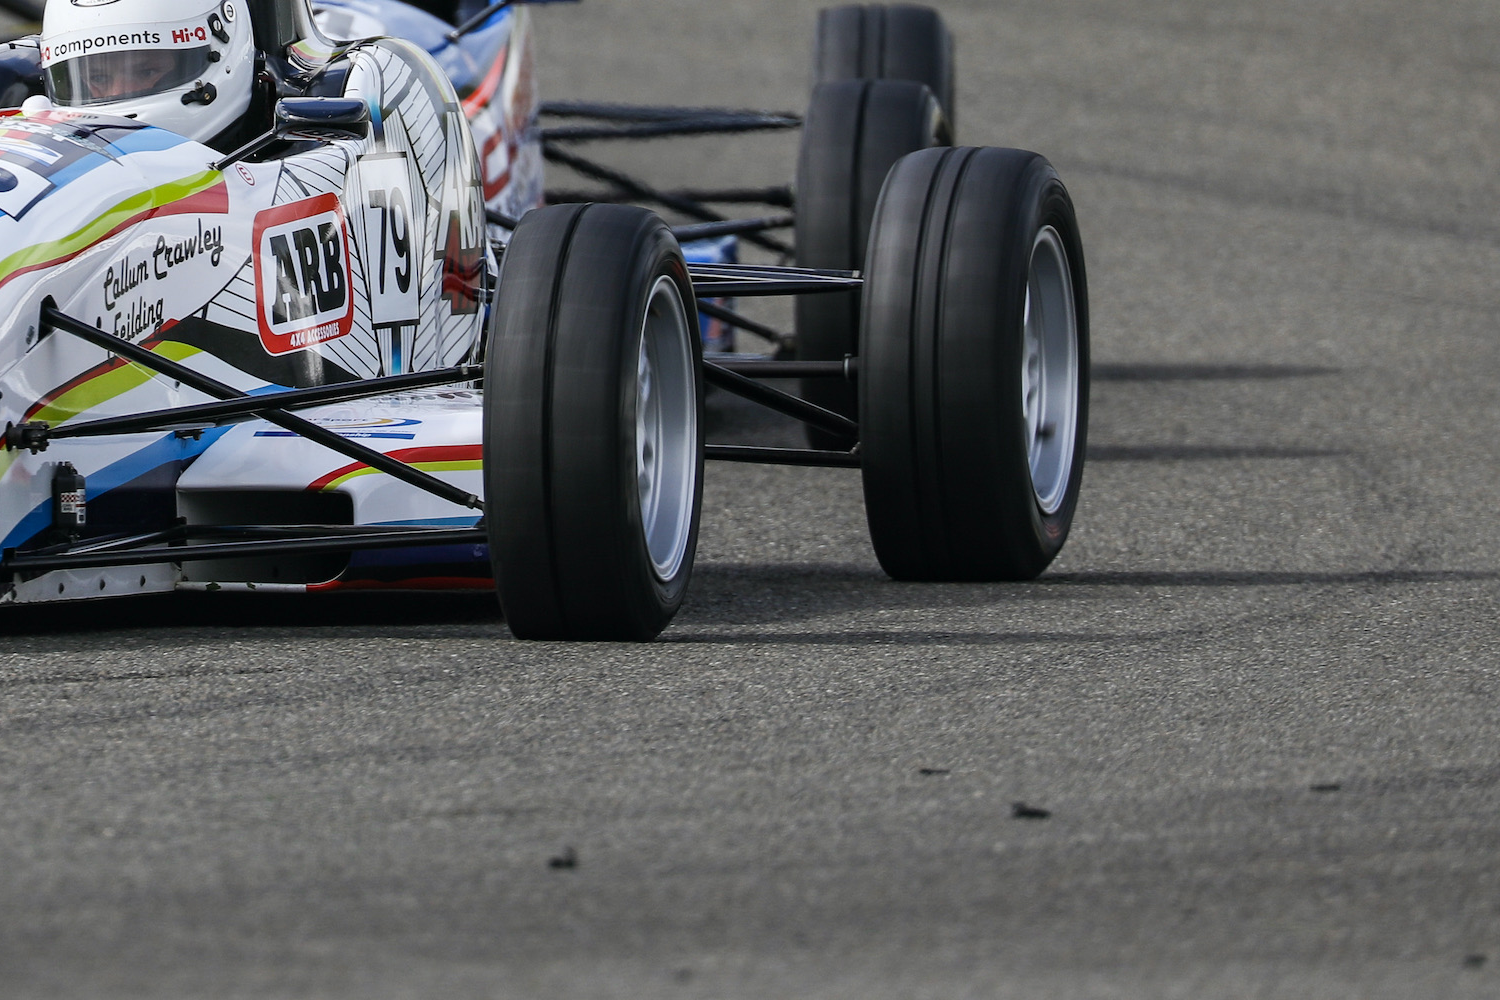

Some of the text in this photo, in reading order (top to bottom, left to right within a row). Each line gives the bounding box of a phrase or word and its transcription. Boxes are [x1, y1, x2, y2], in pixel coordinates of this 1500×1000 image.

[54, 30, 161, 56] components
[103, 217, 224, 311] Callum Crawley
[269, 221, 347, 325] ARB
[368, 187, 411, 294] 79
